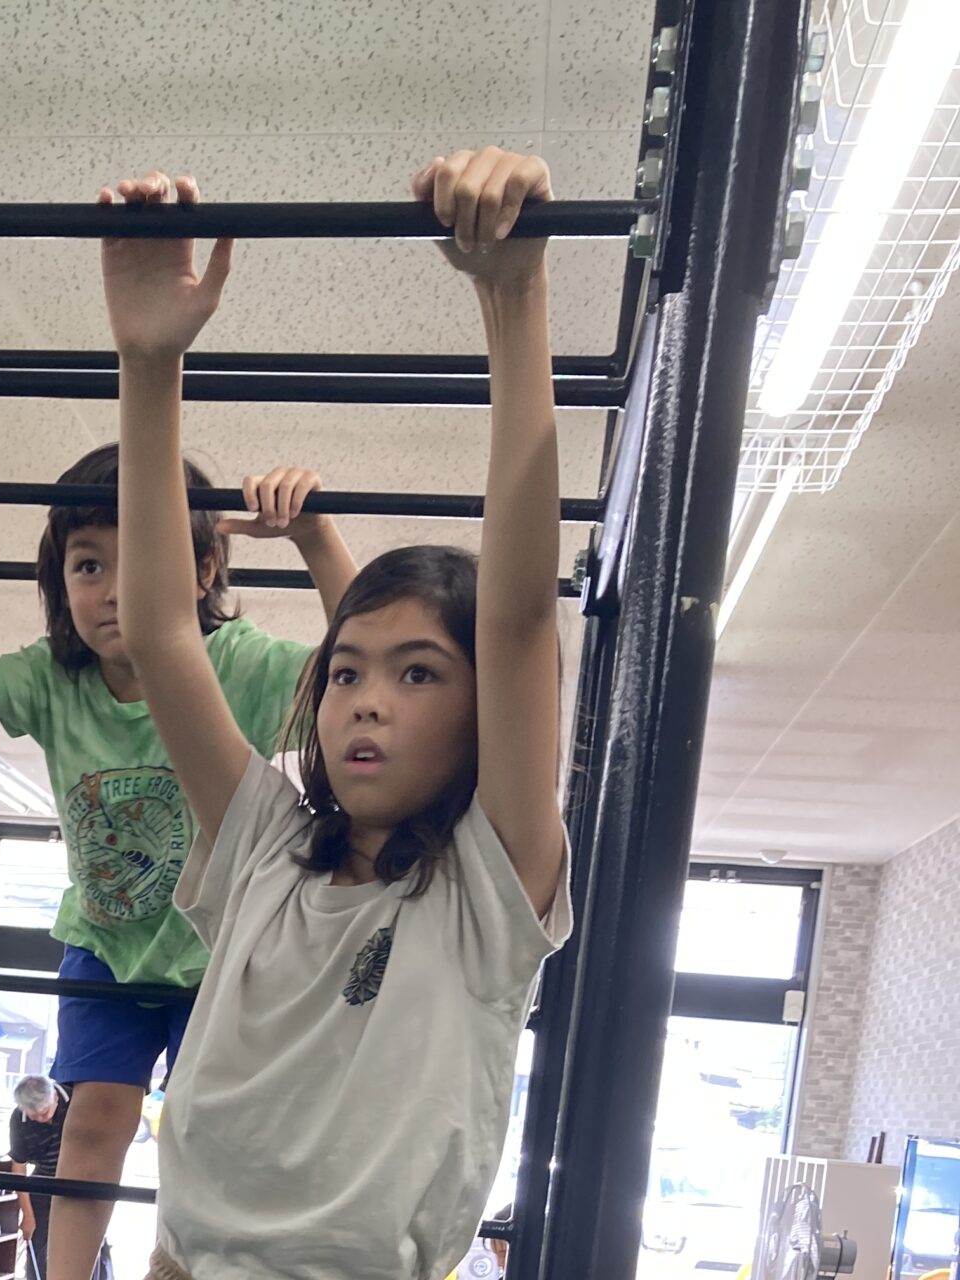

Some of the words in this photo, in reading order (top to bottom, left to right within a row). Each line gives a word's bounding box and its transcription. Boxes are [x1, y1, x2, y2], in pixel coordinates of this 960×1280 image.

[103, 776, 141, 800] TREE
[147, 776, 179, 800] FROG
[154, 860, 183, 901] COSTA
[170, 810, 184, 850] RICA
